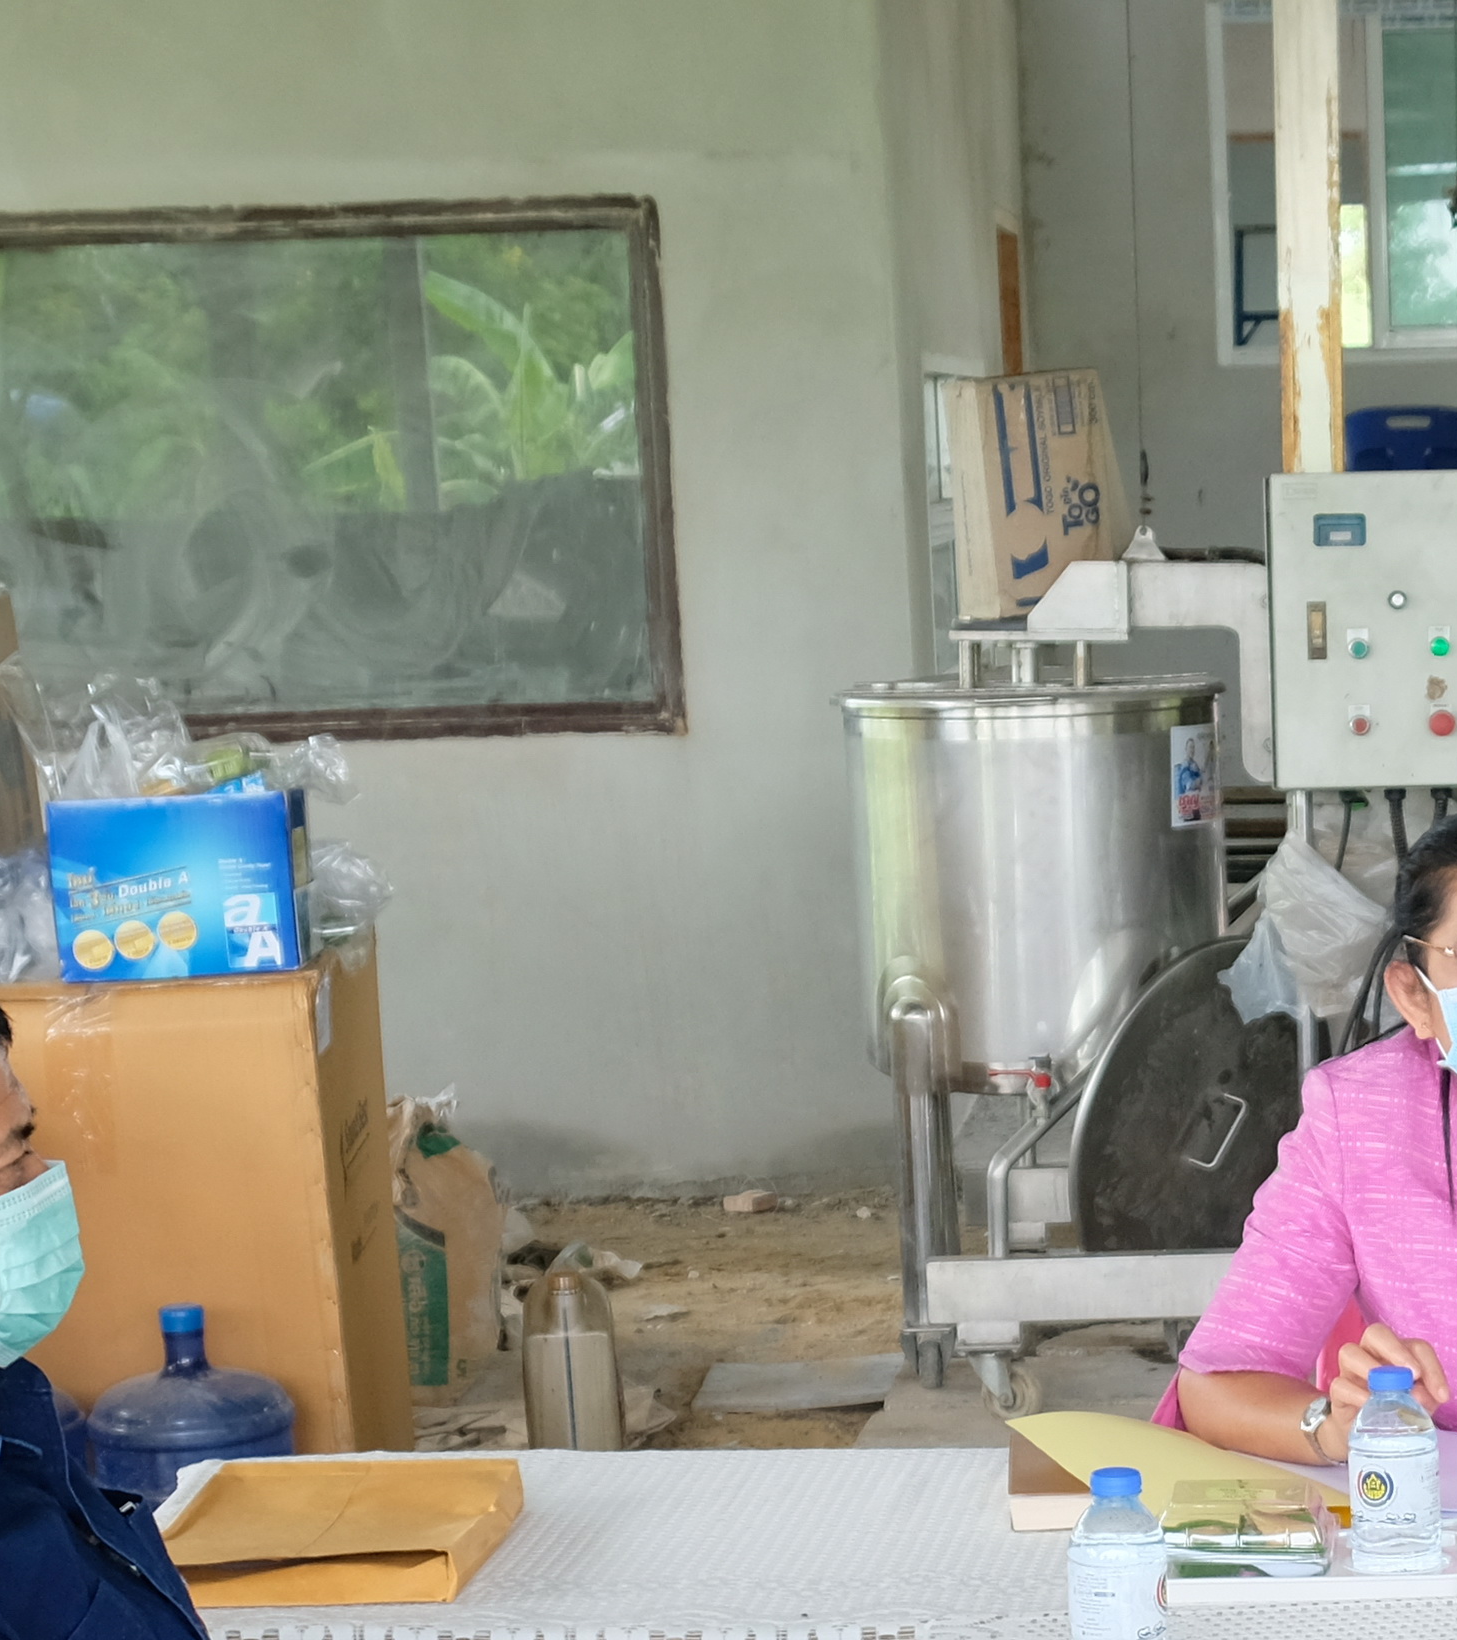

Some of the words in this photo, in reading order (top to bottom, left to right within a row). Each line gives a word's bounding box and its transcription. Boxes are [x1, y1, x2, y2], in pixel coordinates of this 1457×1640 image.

[1039, 435, 1052, 482] ORIGINAL
[118, 876, 172, 898] Double
[178, 871, 189, 884] A
